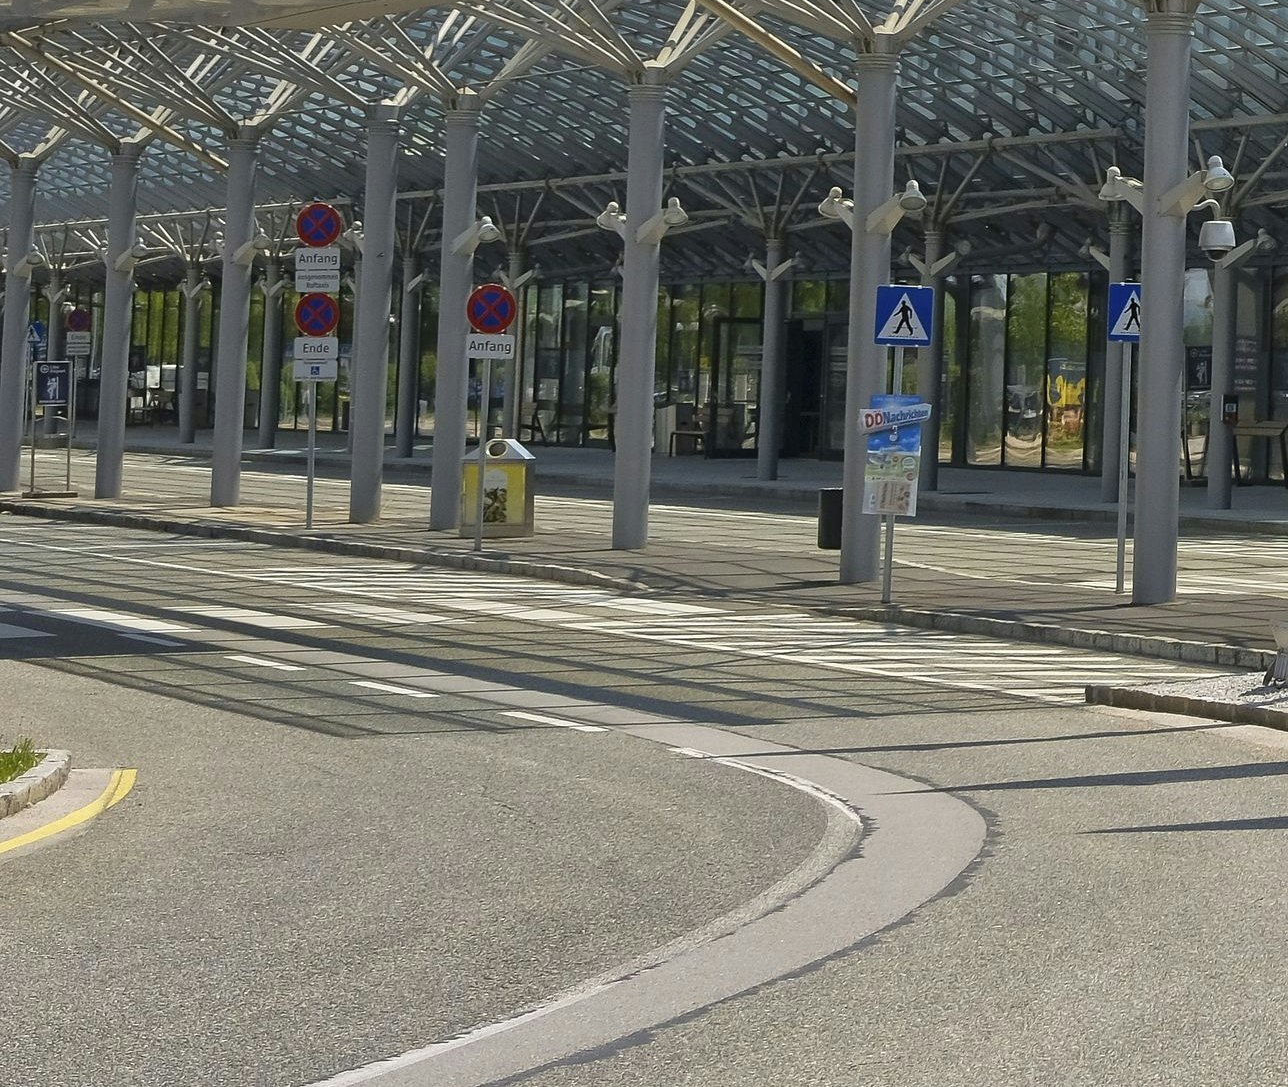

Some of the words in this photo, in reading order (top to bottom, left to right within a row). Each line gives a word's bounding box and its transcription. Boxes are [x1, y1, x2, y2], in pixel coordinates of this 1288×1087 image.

[298, 253, 338, 265] Anfang
[302, 342, 330, 354] Ende
[469, 340, 512, 355] Anfang
